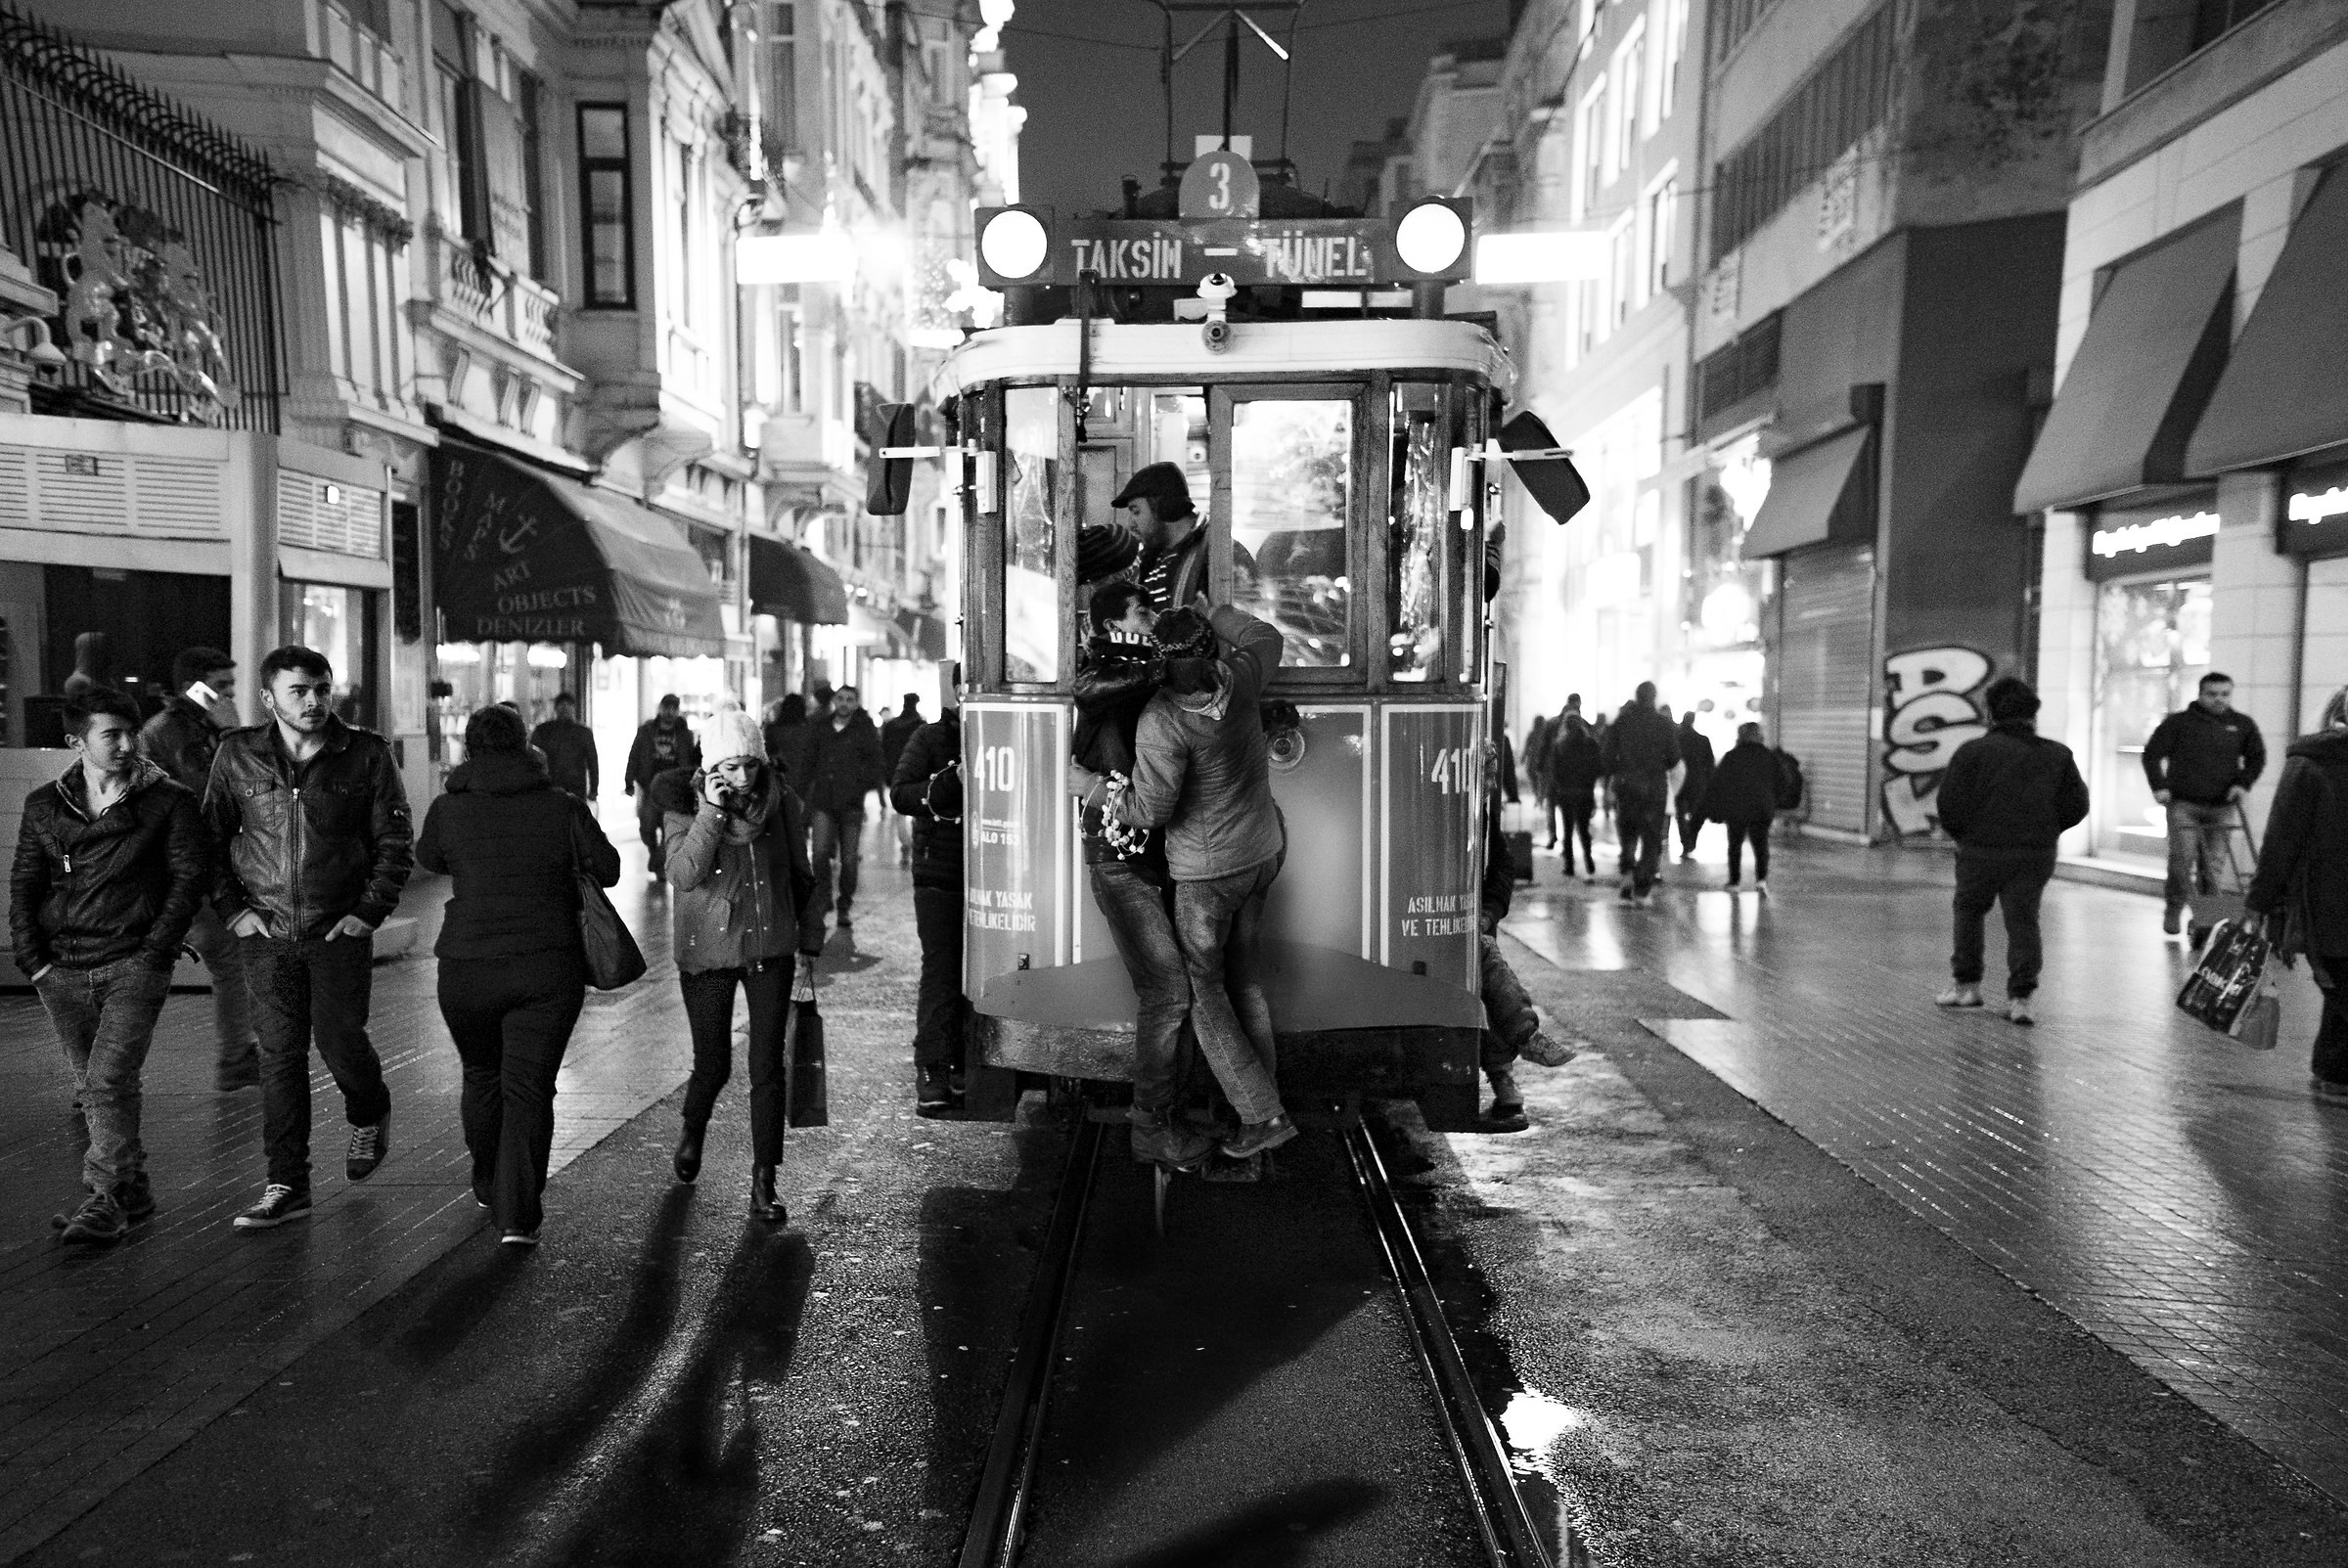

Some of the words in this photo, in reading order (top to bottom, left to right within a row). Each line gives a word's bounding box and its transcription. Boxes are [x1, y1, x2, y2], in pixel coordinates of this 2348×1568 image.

[1208, 162, 1230, 209] 3
[1071, 231, 1183, 279] TAKSİM
[1263, 230, 1367, 278] TÜNEL
[438, 460, 465, 550] BOOKS
[464, 491, 507, 561] MAPS
[492, 560, 532, 592] ART
[497, 585, 597, 614] OBJECTS
[974, 745, 1015, 792] 410
[996, 890, 1032, 910] YASAK
[1402, 918, 1419, 936] VE
